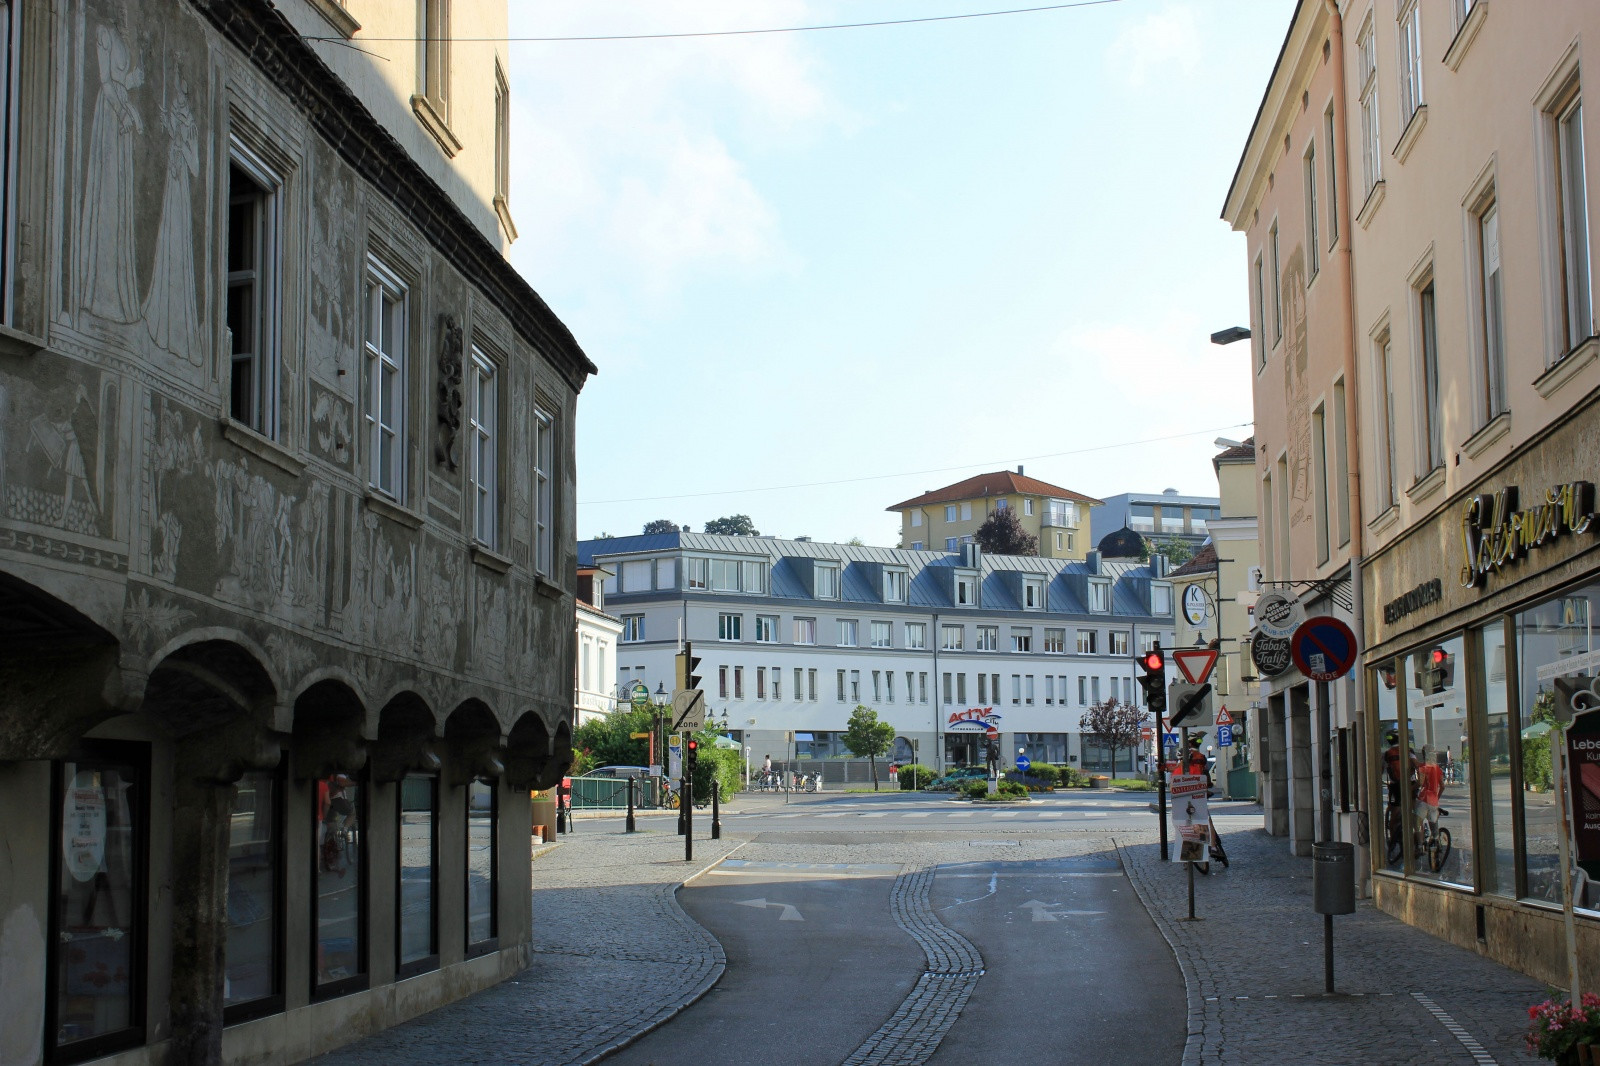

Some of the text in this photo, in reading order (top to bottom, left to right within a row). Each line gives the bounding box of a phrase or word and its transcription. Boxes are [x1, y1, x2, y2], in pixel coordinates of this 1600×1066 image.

[1191, 588, 1198, 601] K
[1259, 598, 1299, 621] MAGISCHE
[1266, 603, 1279, 612] DIE
[1256, 640, 1288, 653] Tabak
[1256, 652, 1288, 664] Trafik
[1310, 671, 1338, 680] ENDE
[1221, 730, 1229, 743] P
